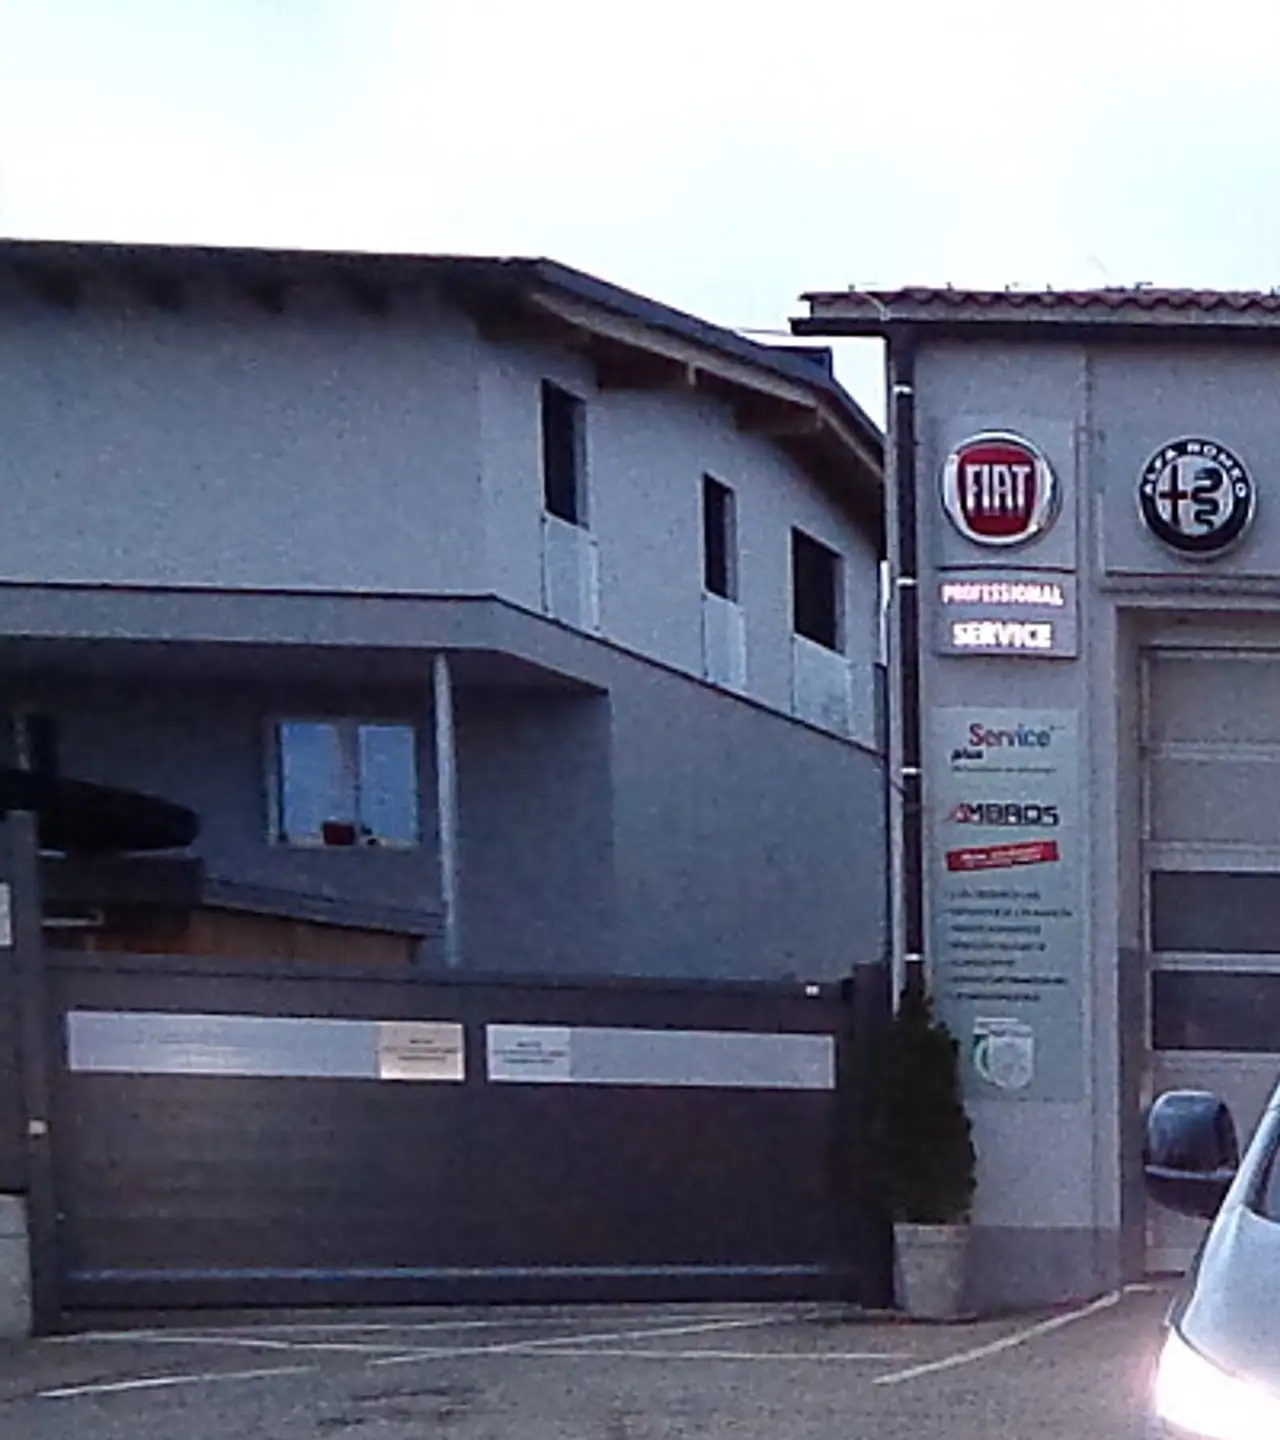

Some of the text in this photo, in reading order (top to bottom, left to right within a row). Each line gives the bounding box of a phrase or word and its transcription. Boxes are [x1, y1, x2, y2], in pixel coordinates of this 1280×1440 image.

[1143, 441, 1247, 498] ALFA ROMEO
[965, 462, 1032, 518] FIAT
[943, 582, 1064, 606] PROFESSIONAL
[953, 621, 1052, 648] SERVICE
[969, 722, 1051, 748] Service
[945, 802, 1059, 827] AMBROS
